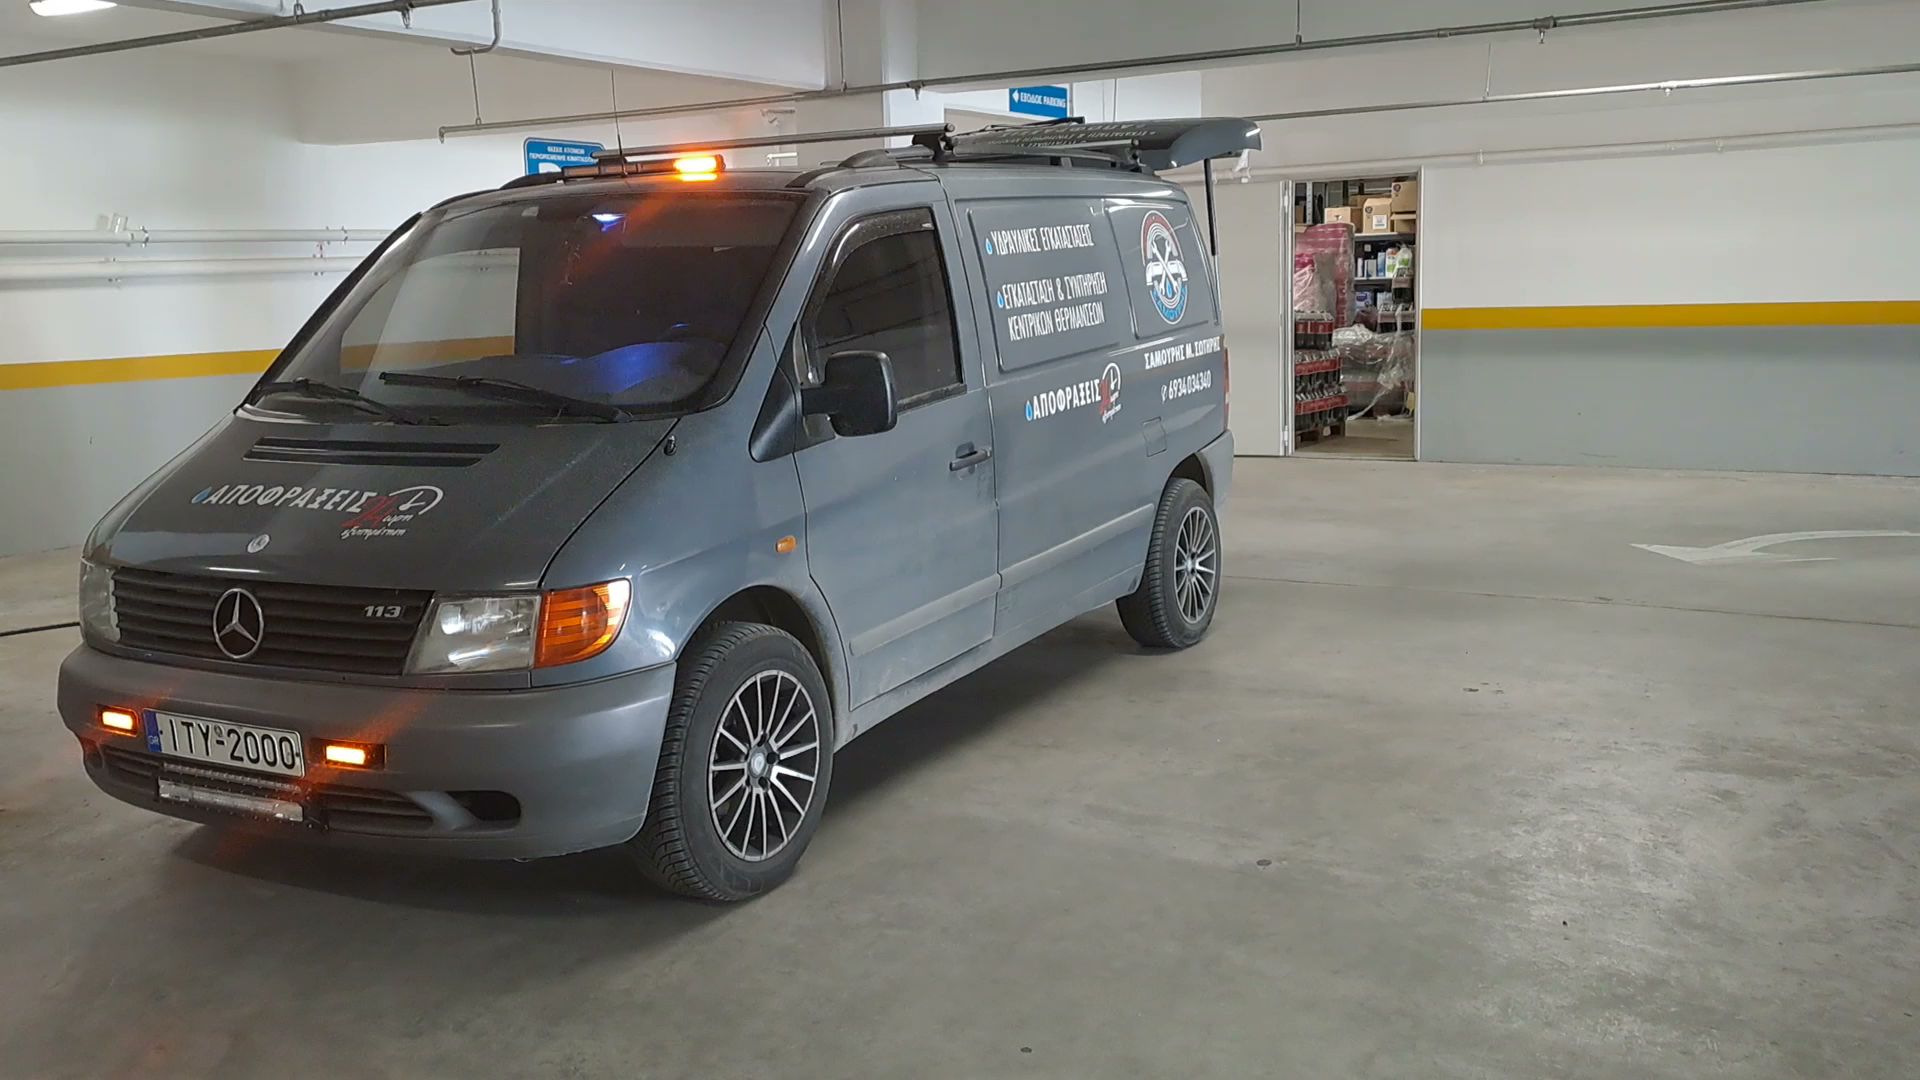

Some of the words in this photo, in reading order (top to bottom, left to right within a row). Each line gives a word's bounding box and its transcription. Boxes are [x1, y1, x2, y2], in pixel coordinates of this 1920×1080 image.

[990, 228, 1041, 255] ΥΔΡΑΥΛΙΚΕΣ
[1040, 224, 1094, 251] ΕΓΚΑΤΑΣΤΑΣΕΙΣ
[1002, 278, 1055, 310] ΕΓΚΑΤΑΣΤΑΣΗ
[1056, 278, 1065, 301] &
[1064, 271, 1108, 300] ΣΥΝΤΗΡΗΣΗ
[1008, 310, 1054, 341] ΚΕΝΤΡΙΚΩΝ
[1054, 301, 1105, 332] ΘΕΡΜΑΝΣΕΩΝ
[1144, 344, 1185, 370] ΣΑΜΟΥΡΗΣ
[1033, 379, 1101, 420] ΑΠΟΦΡΑΞΕΙΣ
[203, 484, 377, 513] ΑΠΟΦΡΑΞΕΙΣ
[364, 605, 402, 618] 113
[169, 719, 296, 770] ITY-2000
